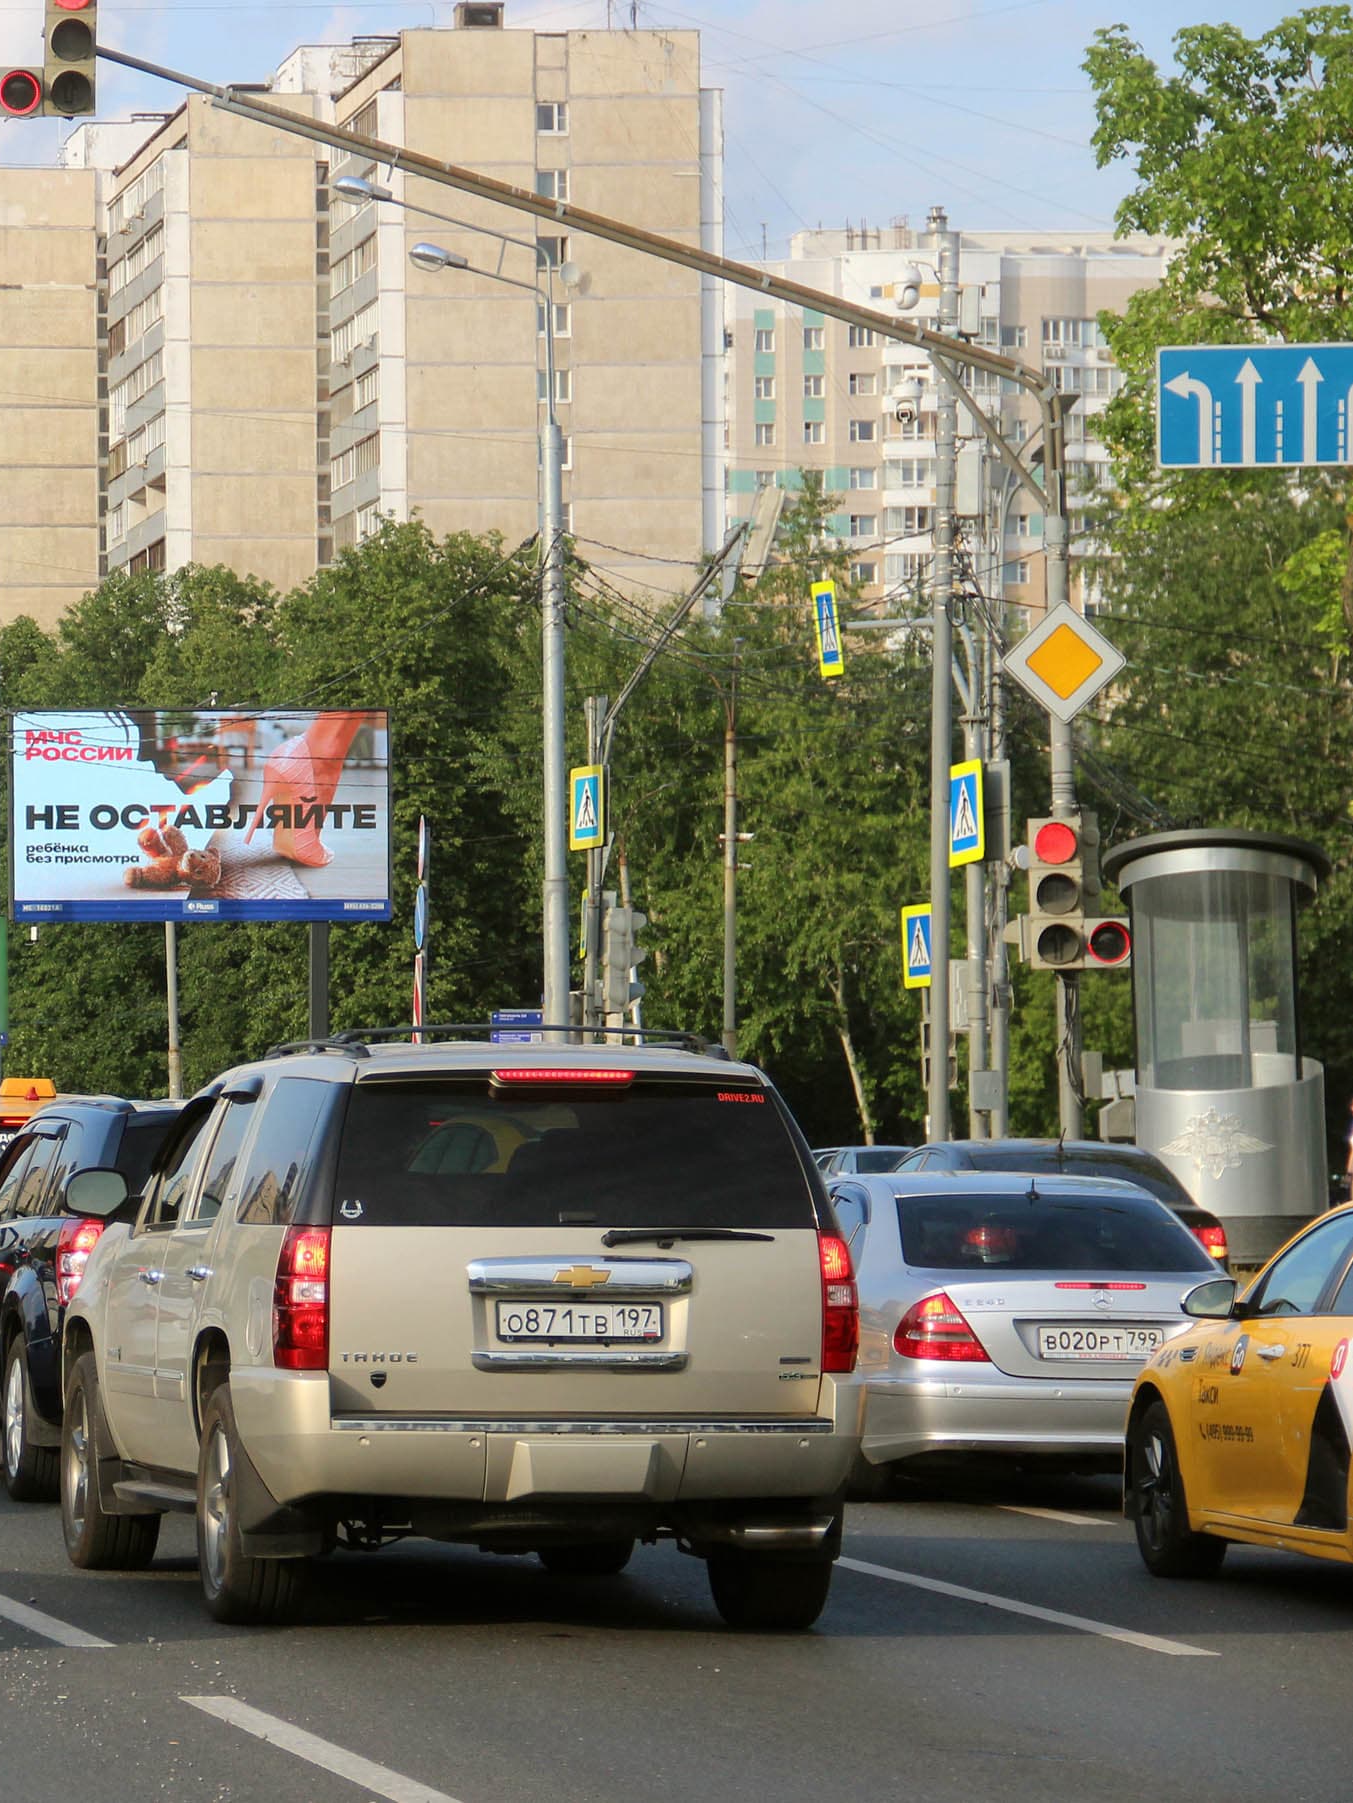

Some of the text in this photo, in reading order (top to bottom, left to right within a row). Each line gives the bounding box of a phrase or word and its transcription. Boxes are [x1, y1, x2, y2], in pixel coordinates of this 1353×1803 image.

[25, 729, 82, 745] МЧС
[25, 746, 133, 761] РОССИИ
[25, 796, 377, 831] НЕ ОСТАВЛЯЙТЕ
[26, 843, 89, 854] ребёнка
[26, 854, 140, 864] без присмотра
[717, 1092, 765, 1104] DRIVE2.RU
[507, 1308, 653, 1335] О871ТВ 197
[1046, 1331, 1158, 1351] В020РТ 799
[341, 1352, 418, 1362] TAHOE
[1232, 1342, 1246, 1368] Go
